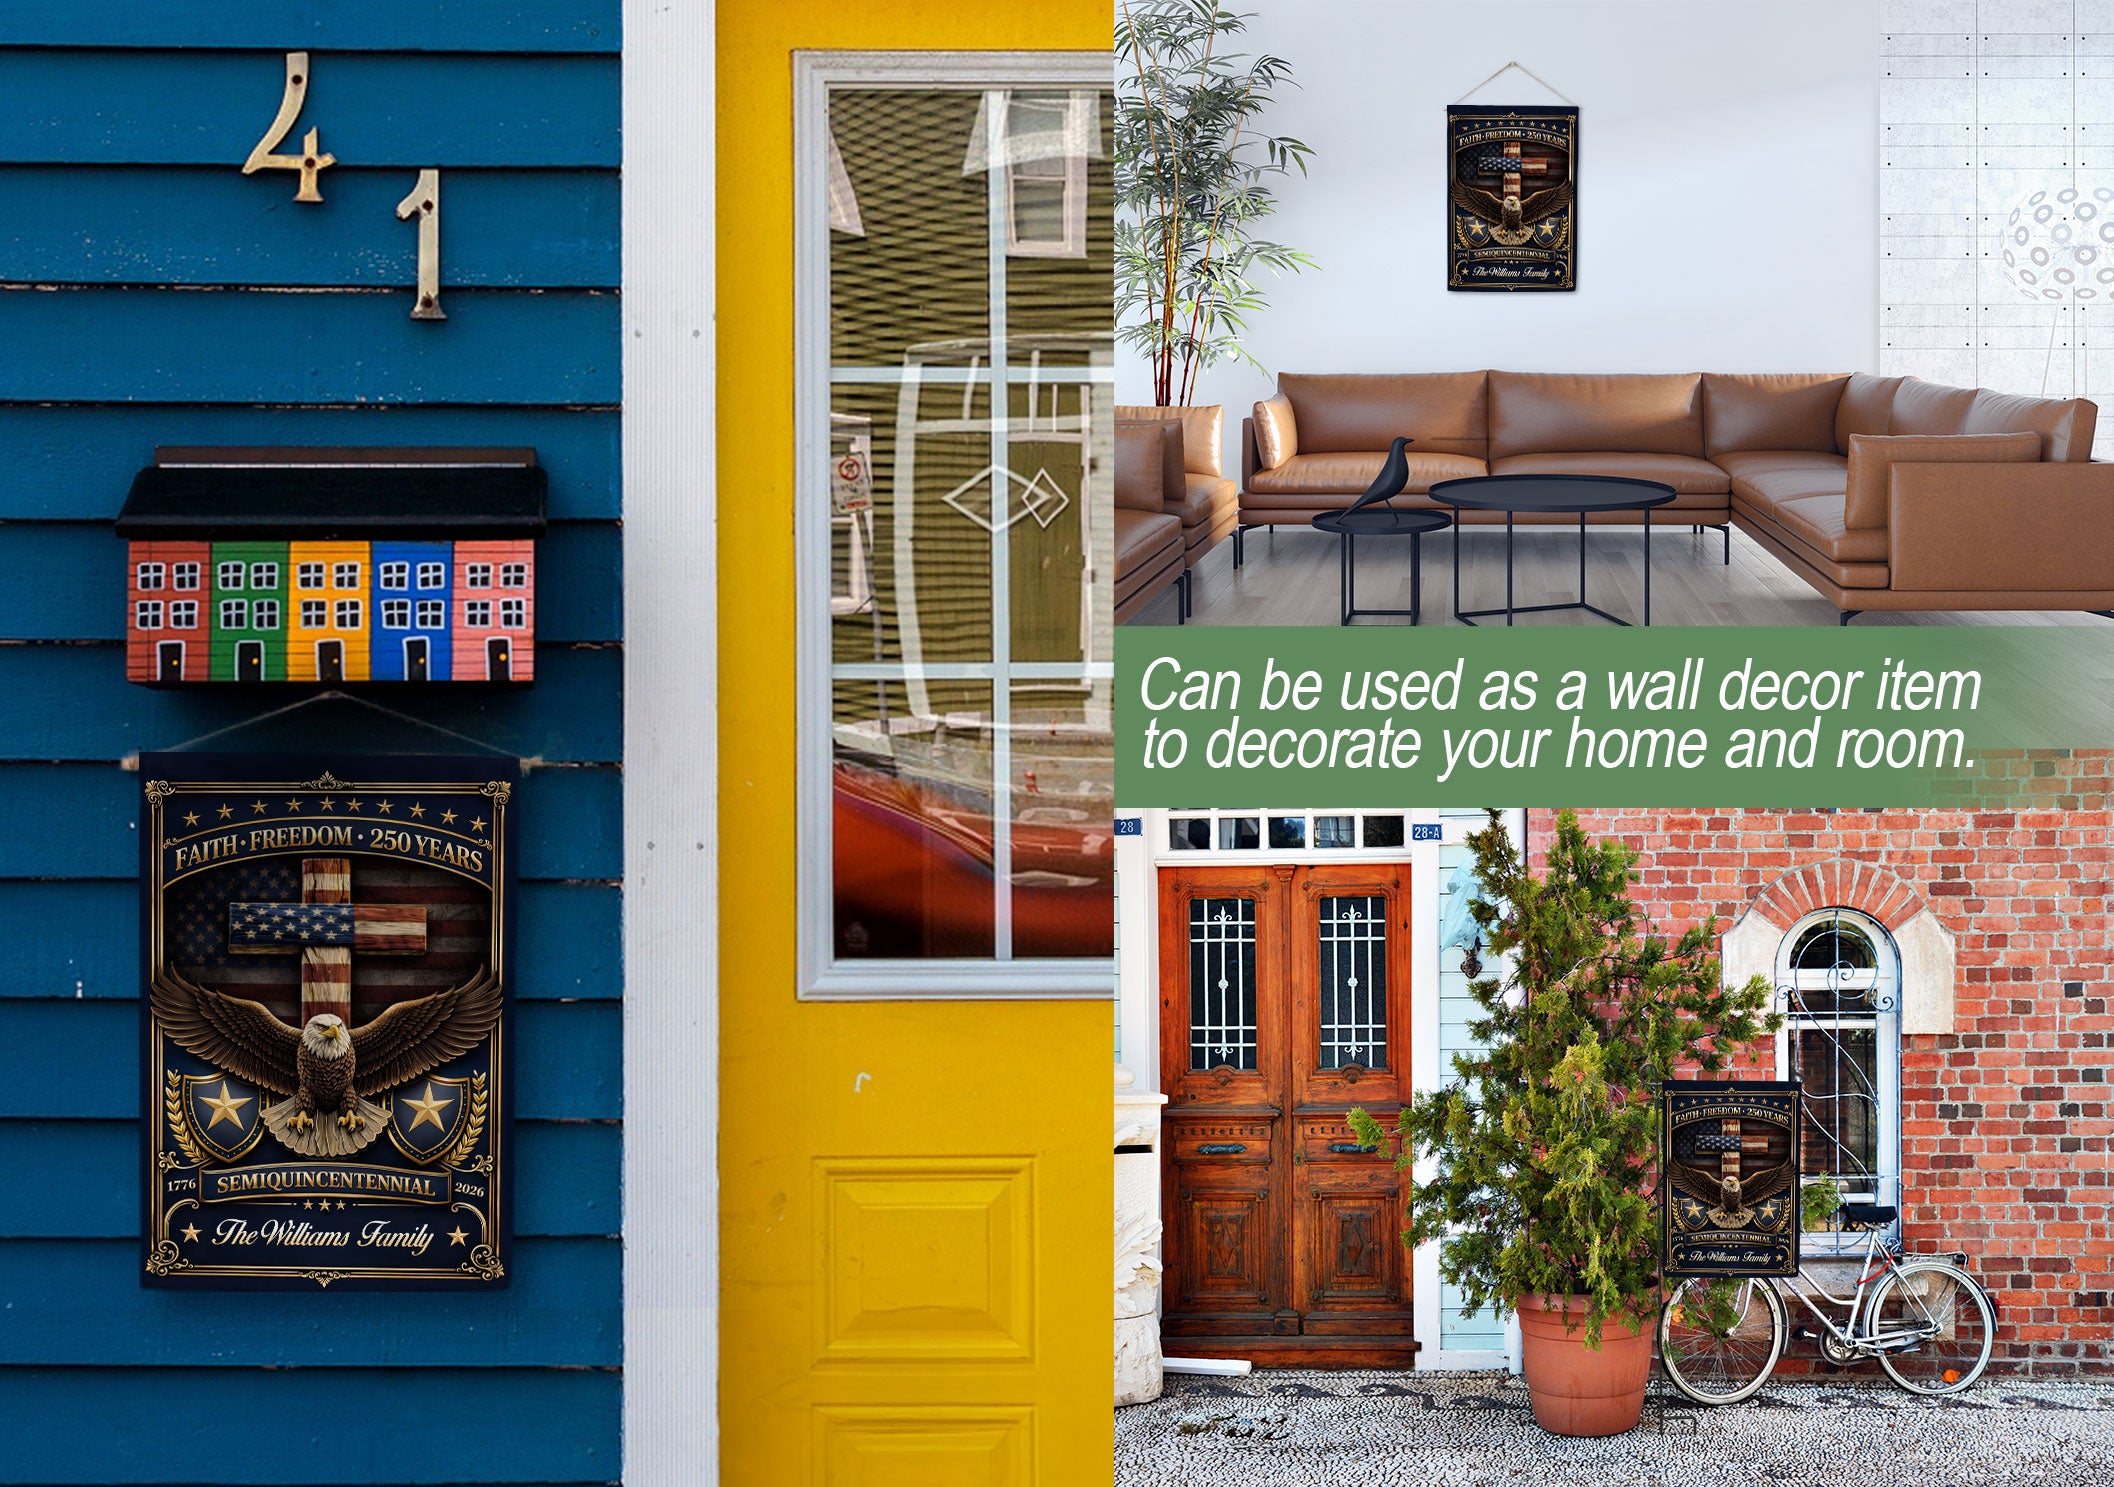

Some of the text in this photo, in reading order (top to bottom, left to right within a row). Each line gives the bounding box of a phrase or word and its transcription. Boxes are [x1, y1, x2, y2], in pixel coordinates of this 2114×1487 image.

[1523, 266, 1550, 280] Family
[1120, 821, 1134, 833] 28
[1414, 826, 1440, 839] 28-A
[175, 825, 483, 873] FAITH FREEDOM 250 YEARS
[1747, 1107, 1762, 1117] 250
[1762, 1110, 1789, 1125] YEARS
[166, 1178, 197, 1192] 1776
[216, 1171, 436, 1197] SEMIQUINCENTENNIAL
[455, 1181, 485, 1198] 2026
[212, 1218, 435, 1257] The Williams Family
[1742, 1251, 1771, 1265] Family
